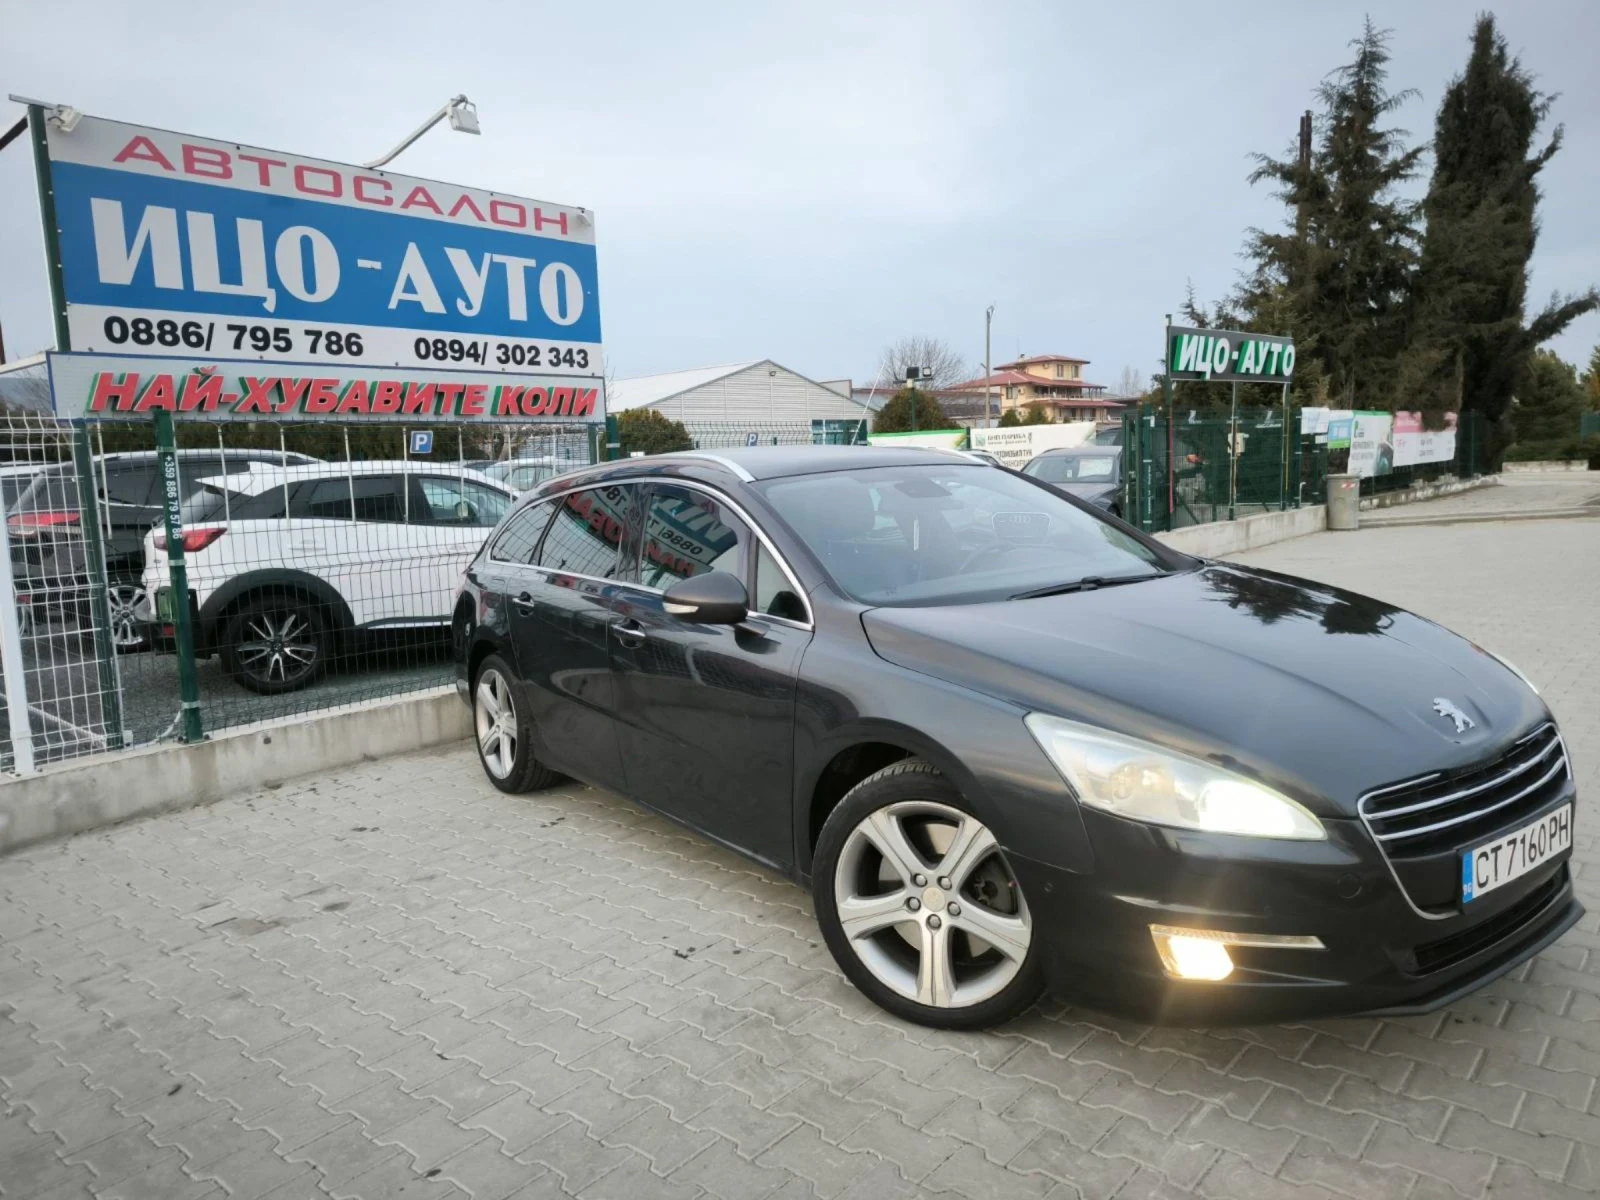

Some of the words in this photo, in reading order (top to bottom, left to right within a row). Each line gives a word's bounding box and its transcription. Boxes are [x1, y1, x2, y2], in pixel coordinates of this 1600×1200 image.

[112, 134, 568, 236] АВТОСАЛОН
[103, 315, 215, 352] 0886/
[226, 324, 293, 353] 795
[304, 329, 364, 357] 786
[413, 336, 488, 365] 0894/
[496, 343, 541, 367] 302
[547, 346, 589, 369] 343
[87, 366, 488, 417] НАЙ-ХУБАВИТЕ
[493, 385, 598, 417] КОЛИ
[415, 433, 428, 451] P
[164, 455, 176, 478] +359
[166, 481, 177, 498] 886
[169, 500, 179, 512] 79
[170, 514, 181, 525] 57
[172, 527, 182, 540] 86
